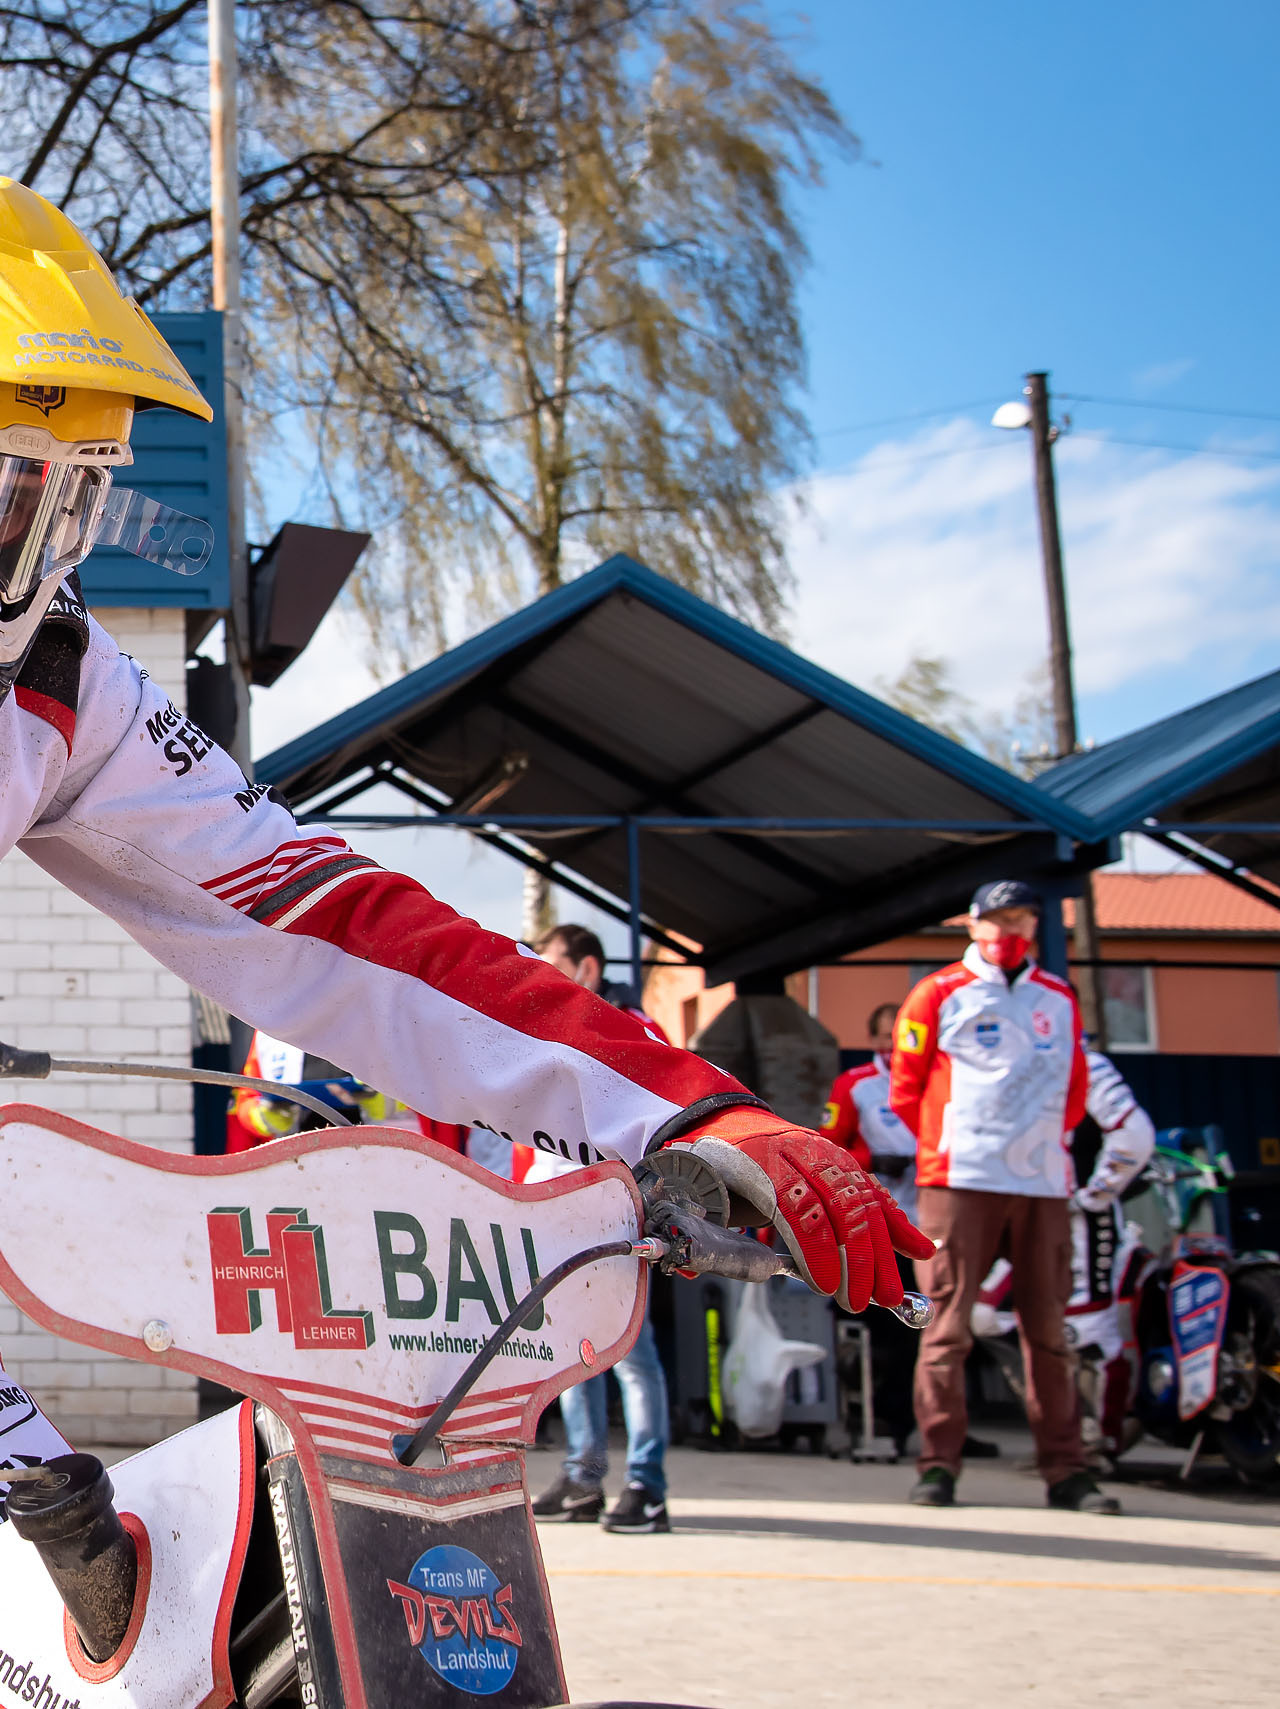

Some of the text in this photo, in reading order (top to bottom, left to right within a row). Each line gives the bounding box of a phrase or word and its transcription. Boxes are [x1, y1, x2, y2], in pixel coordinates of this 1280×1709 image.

[214, 1265, 285, 1281] HEINRICH
[372, 1209, 547, 1332] BAU
[302, 1326, 357, 1341] LEHNER
[389, 1331, 555, 1362] www.lehner-hinrich.de
[420, 1567, 487, 1588] Trans MF
[386, 1578, 523, 1647] DEVILS
[436, 1647, 511, 1671] Landshut
